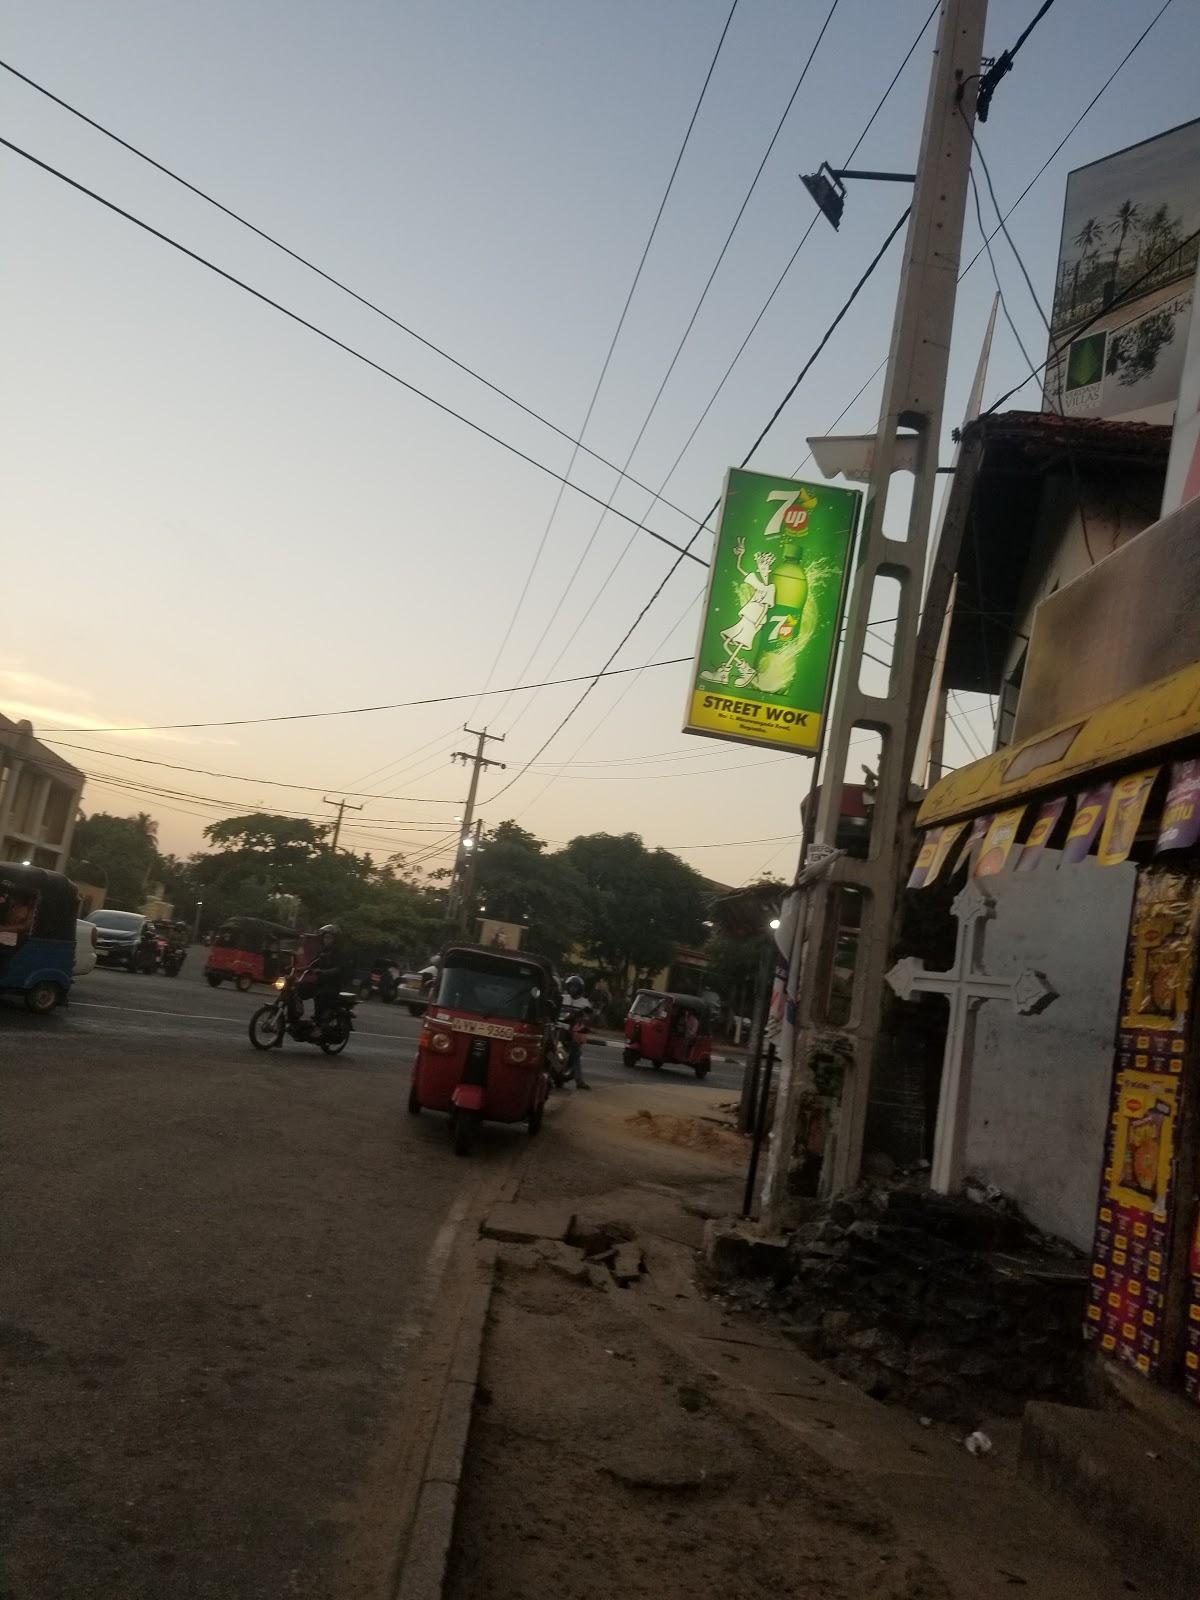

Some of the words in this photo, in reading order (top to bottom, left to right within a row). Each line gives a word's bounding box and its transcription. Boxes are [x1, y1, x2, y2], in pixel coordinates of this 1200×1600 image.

[763, 490, 808, 536] 7up
[703, 695, 762, 717] STREET
[766, 706, 809, 727] WOK
